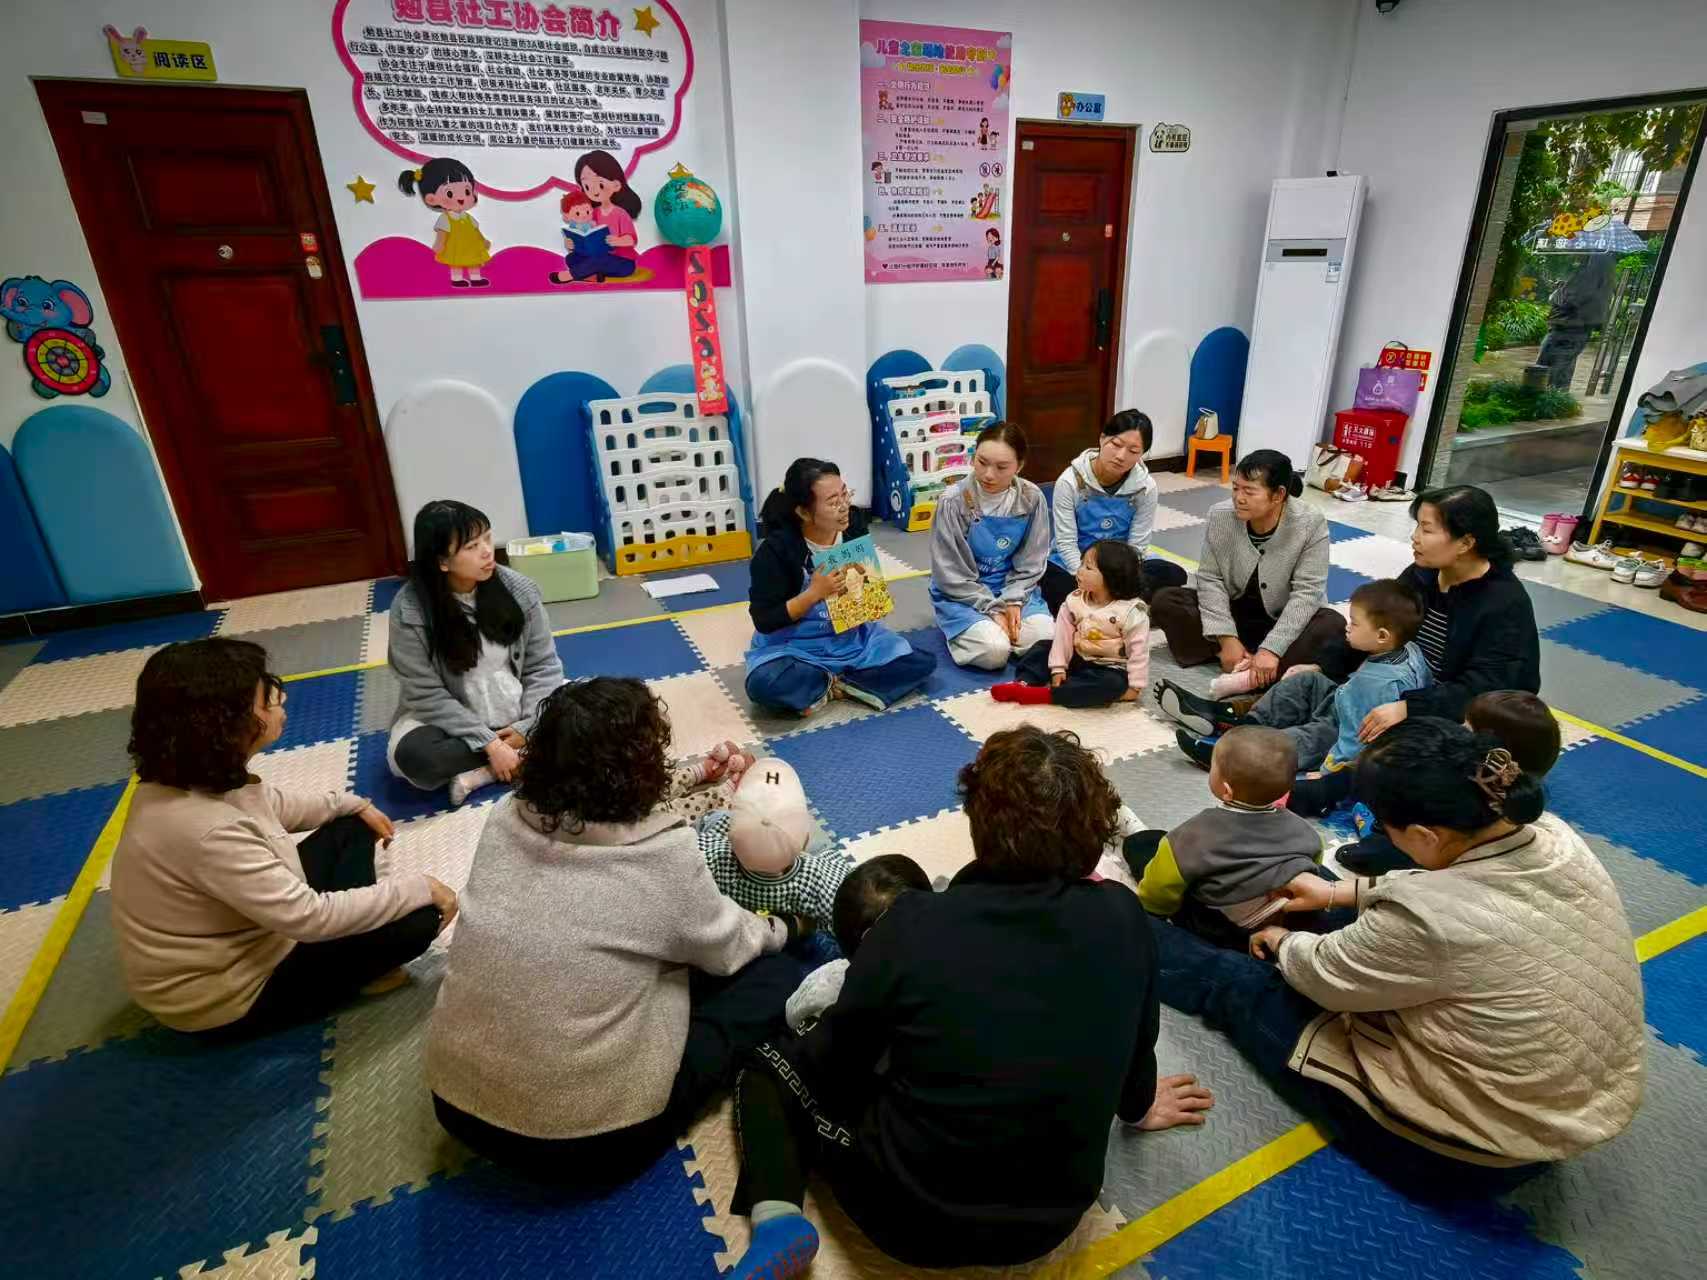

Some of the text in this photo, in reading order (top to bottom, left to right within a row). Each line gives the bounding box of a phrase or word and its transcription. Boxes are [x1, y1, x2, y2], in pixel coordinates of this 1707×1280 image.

[393, 0, 621, 39] 勉县社工协会简介
[153, 51, 208, 70] 阅读区
[1076, 101, 1102, 114] 办公室
[766, 771, 780, 785] H
